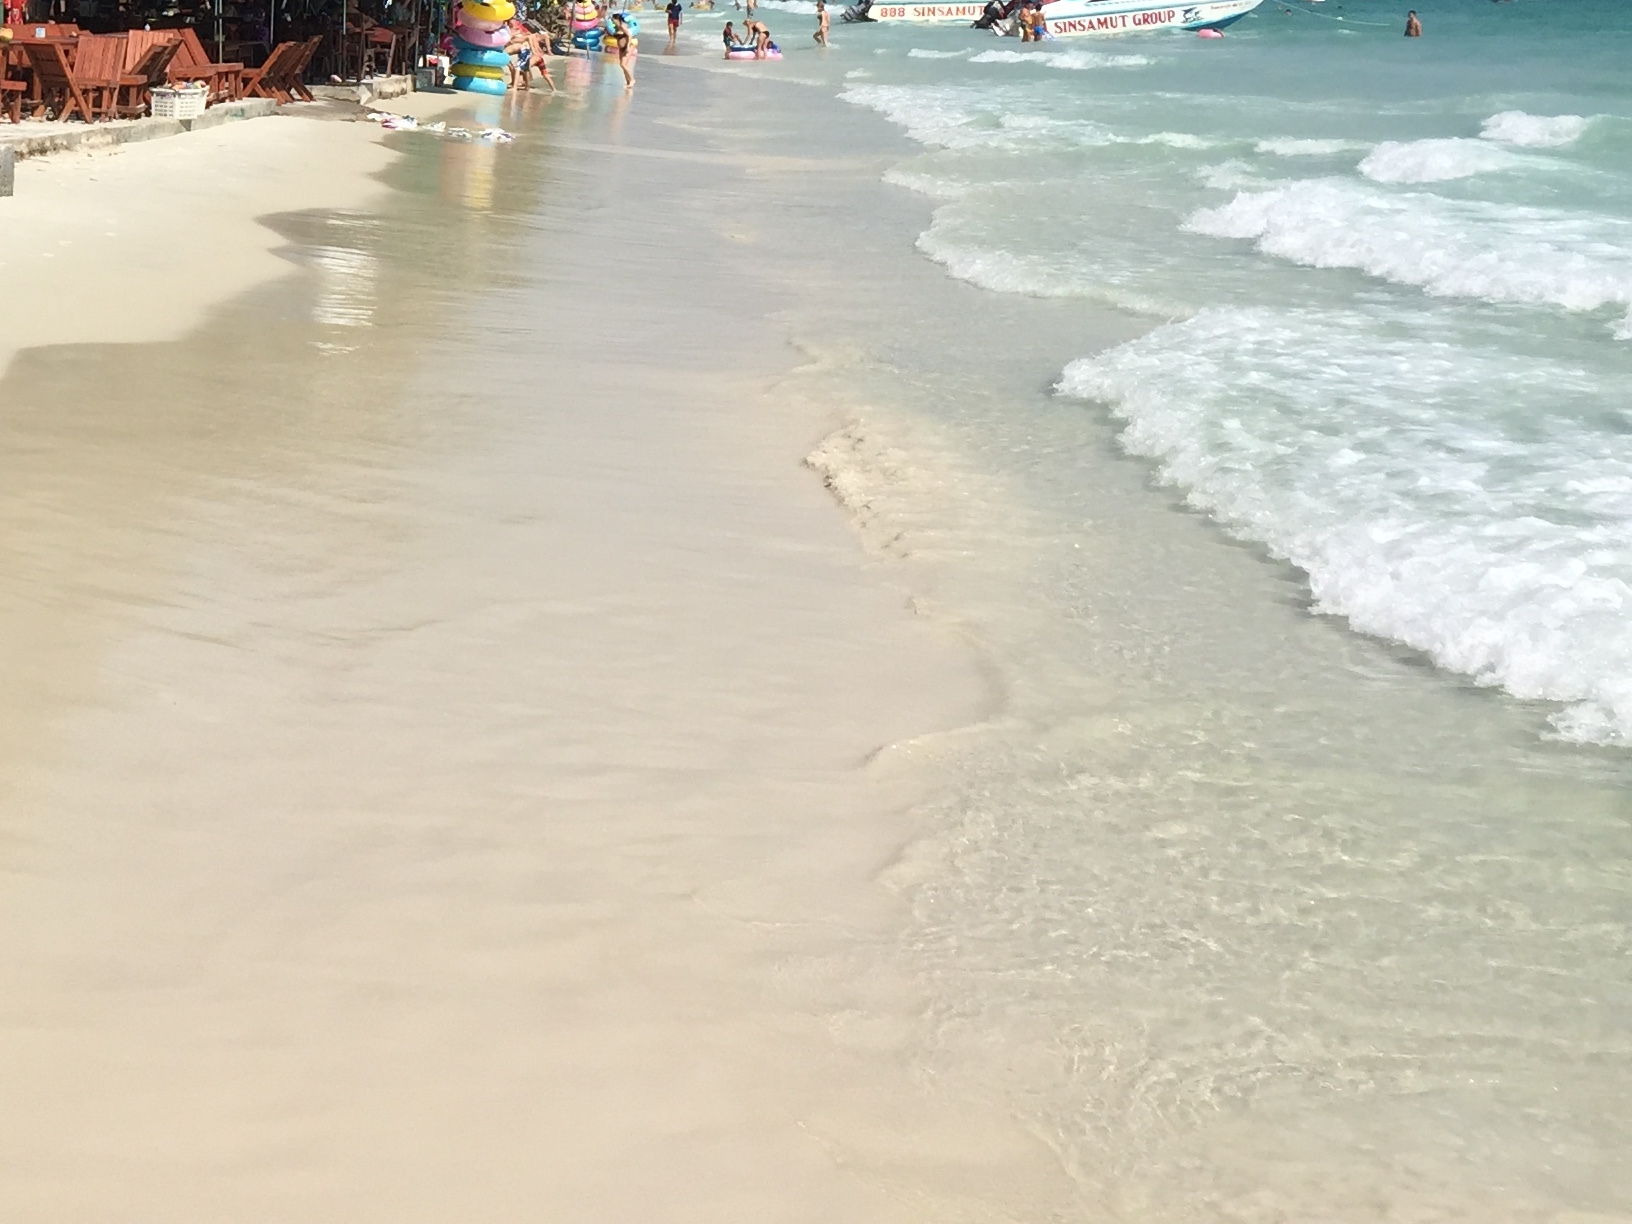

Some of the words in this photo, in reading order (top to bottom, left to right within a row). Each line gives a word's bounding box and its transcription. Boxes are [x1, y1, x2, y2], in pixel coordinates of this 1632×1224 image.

[880, 6, 906, 18] 888
[913, 4, 986, 17] SINSAMUT
[1053, 14, 1129, 34] SINSAMUT
[1132, 9, 1176, 27] GROUP
